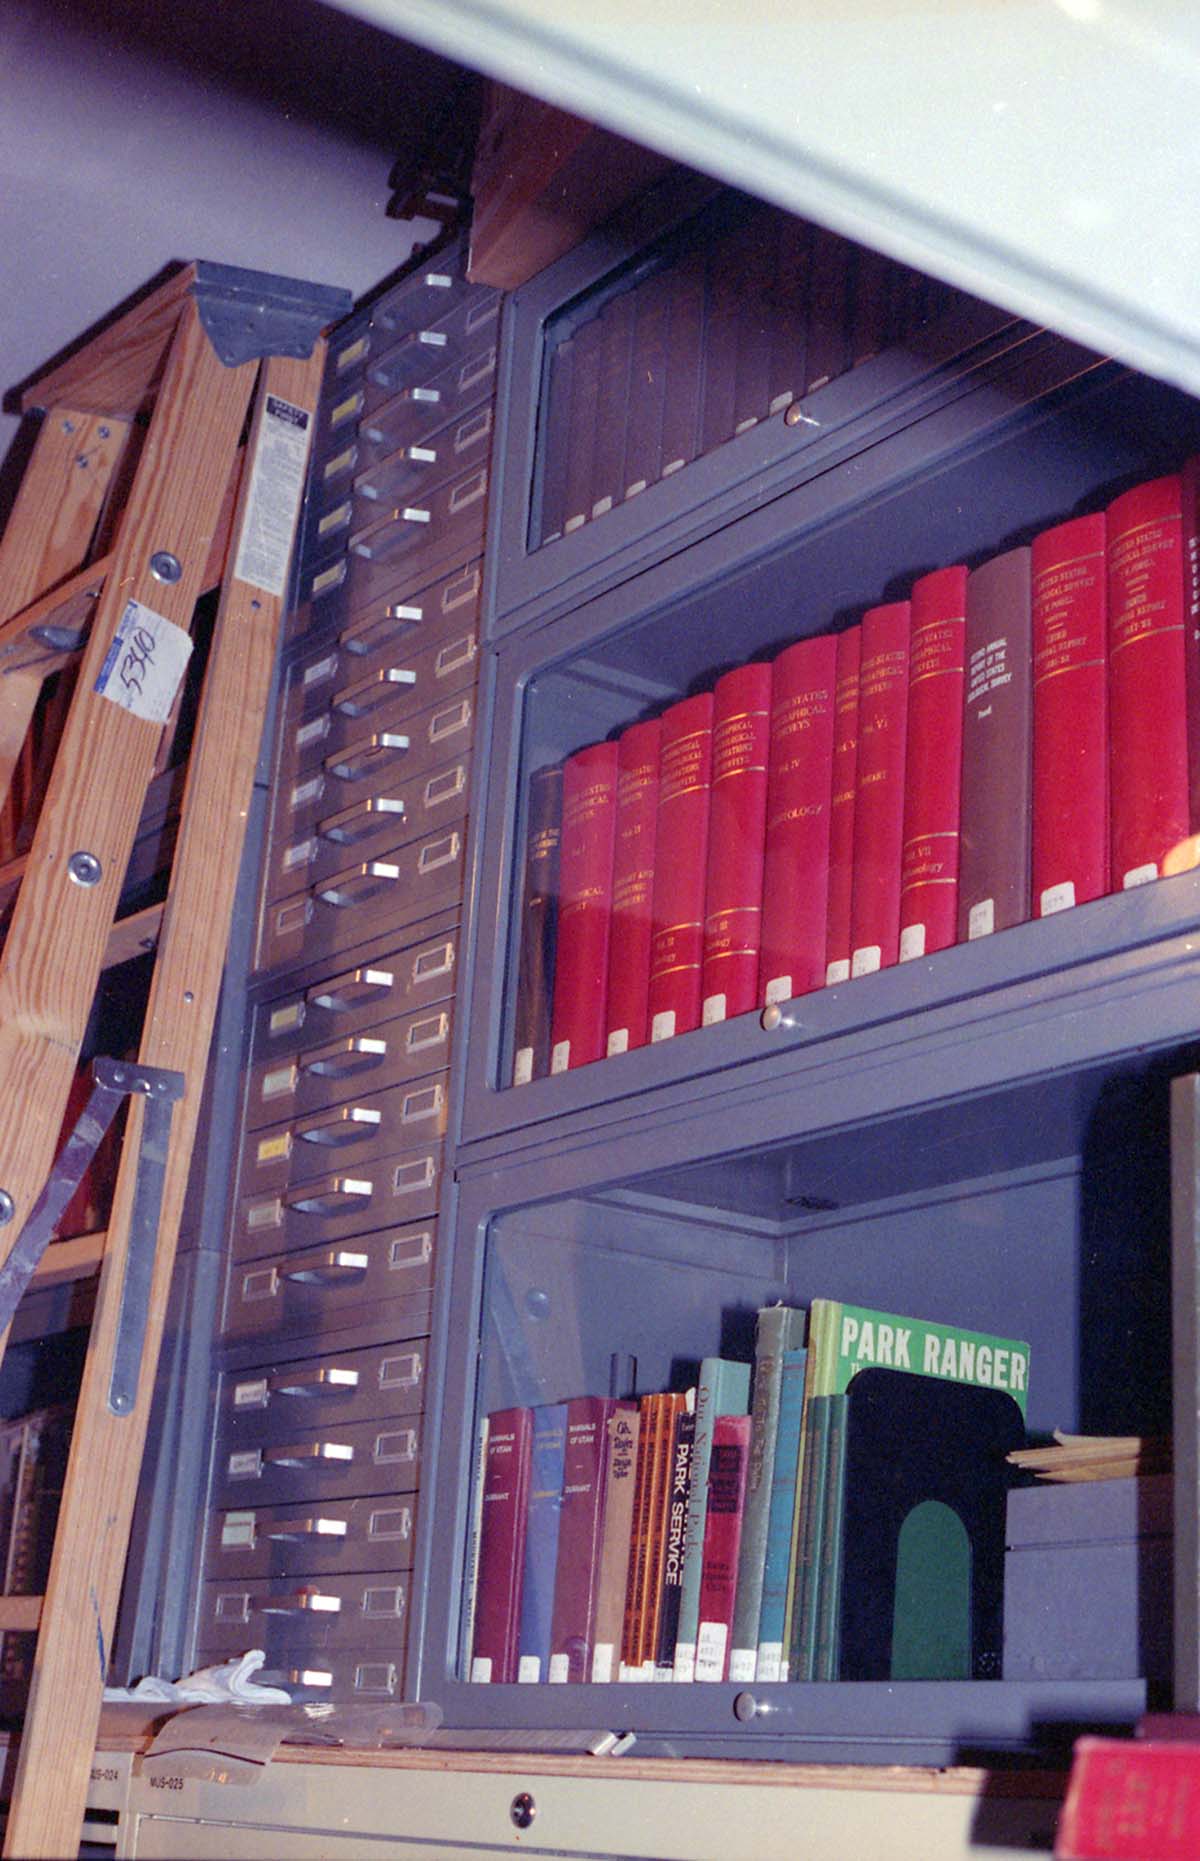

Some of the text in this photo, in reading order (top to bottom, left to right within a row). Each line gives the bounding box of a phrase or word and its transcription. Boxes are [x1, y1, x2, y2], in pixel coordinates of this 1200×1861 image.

[120, 627, 156, 696] 5340
[841, 1317, 1026, 1391] PARK RANGER
[673, 1443, 689, 1495] PARK
[690, 1432, 706, 1502] National
[665, 1502, 684, 1585] SERVICE
[685, 1514, 700, 1560] Parks
[150, 1777, 184, 1790] MUS-025
